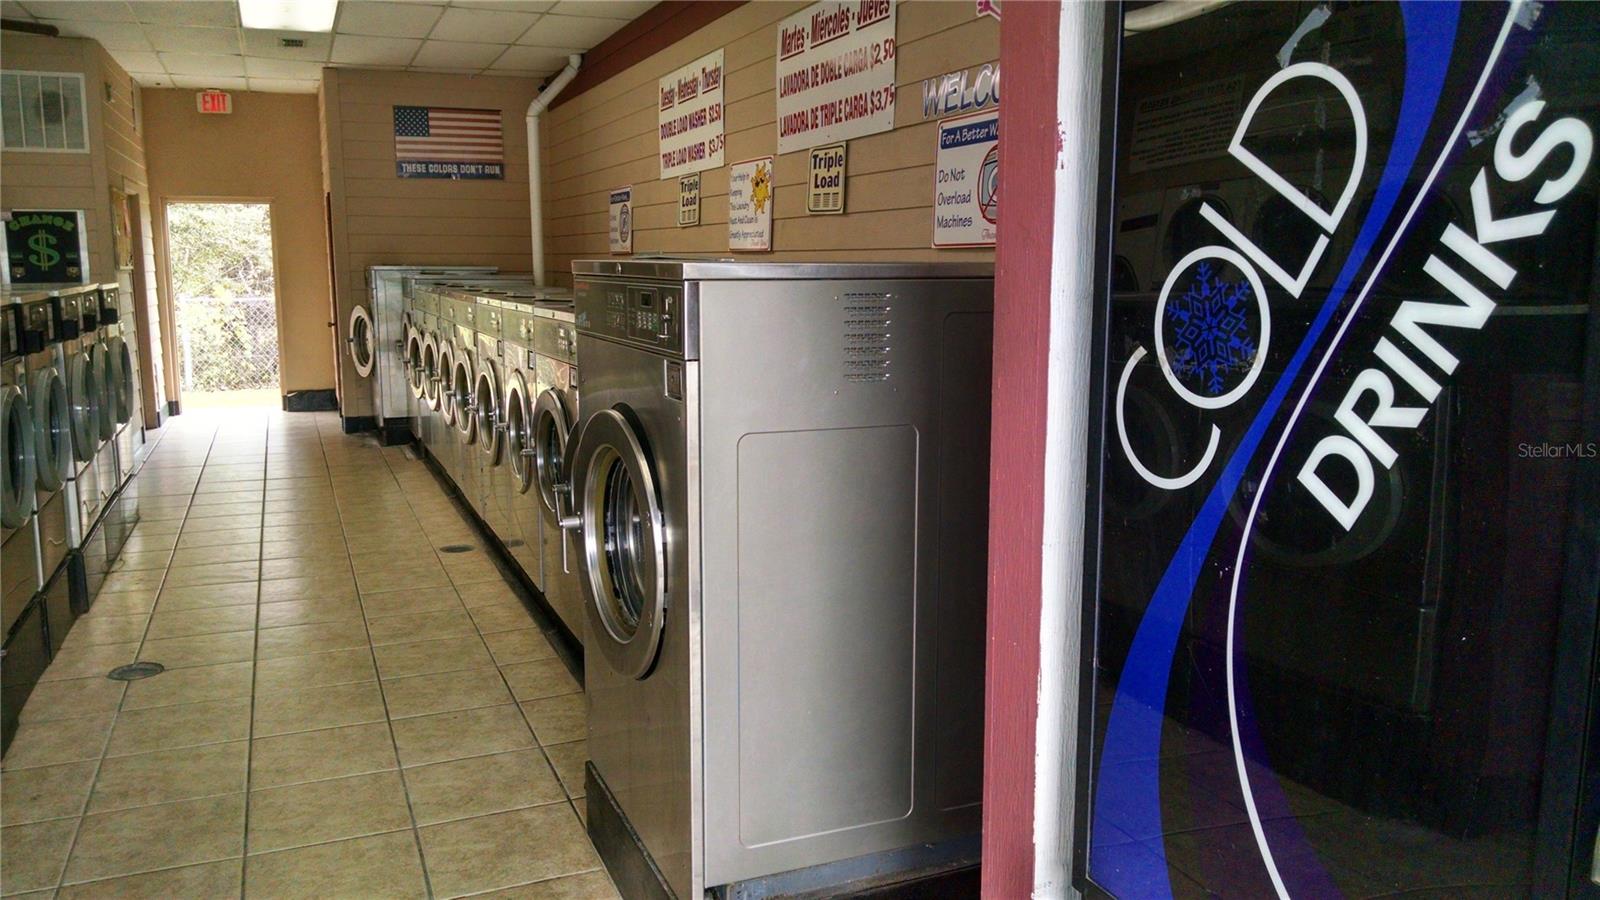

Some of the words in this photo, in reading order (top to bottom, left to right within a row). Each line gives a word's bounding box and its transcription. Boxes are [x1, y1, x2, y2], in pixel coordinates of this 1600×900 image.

[781, 24, 805, 56] Martes
[811, 3, 850, 44] Miércoles
[857, 0, 890, 25] Jueves
[780, 68, 810, 98] LAVADORA
[811, 64, 819, 88] DE
[821, 56, 842, 85] DOBLE
[843, 46, 868, 77] CARGA
[202, 93, 228, 112] EXIT
[780, 109, 810, 137] LAVADORA
[810, 106, 819, 130] DE
[820, 98, 843, 127] TRIPLE
[844, 92, 868, 121] CARGA
[870, 83, 894, 117] $3.75
[660, 119, 677, 140] DOUBLE
[677, 114, 688, 135] LOAD
[688, 107, 707, 131] WASHER
[942, 132, 955, 146] For
[954, 129, 961, 143] A
[961, 126, 989, 142] Better
[662, 151, 676, 169] TRIPLE
[676, 147, 687, 166] LOAD
[687, 141, 705, 163] WASHER
[812, 151, 844, 172] Triple
[402, 163, 427, 173] THESE
[428, 163, 458, 174] COLORS
[460, 163, 482, 174] DON'T
[484, 164, 500, 174] RUN
[938, 169, 949, 184] Do
[950, 167, 966, 182] Not
[681, 178, 699, 195] Triple
[814, 170, 840, 189] Load
[682, 193, 697, 208] Load
[937, 188, 971, 206] Overload
[9, 214, 75, 231] CHANGE
[937, 213, 973, 229] Machines
[1116, 61, 1368, 490] COLD
[1297, 100, 1593, 532] DRINKS
